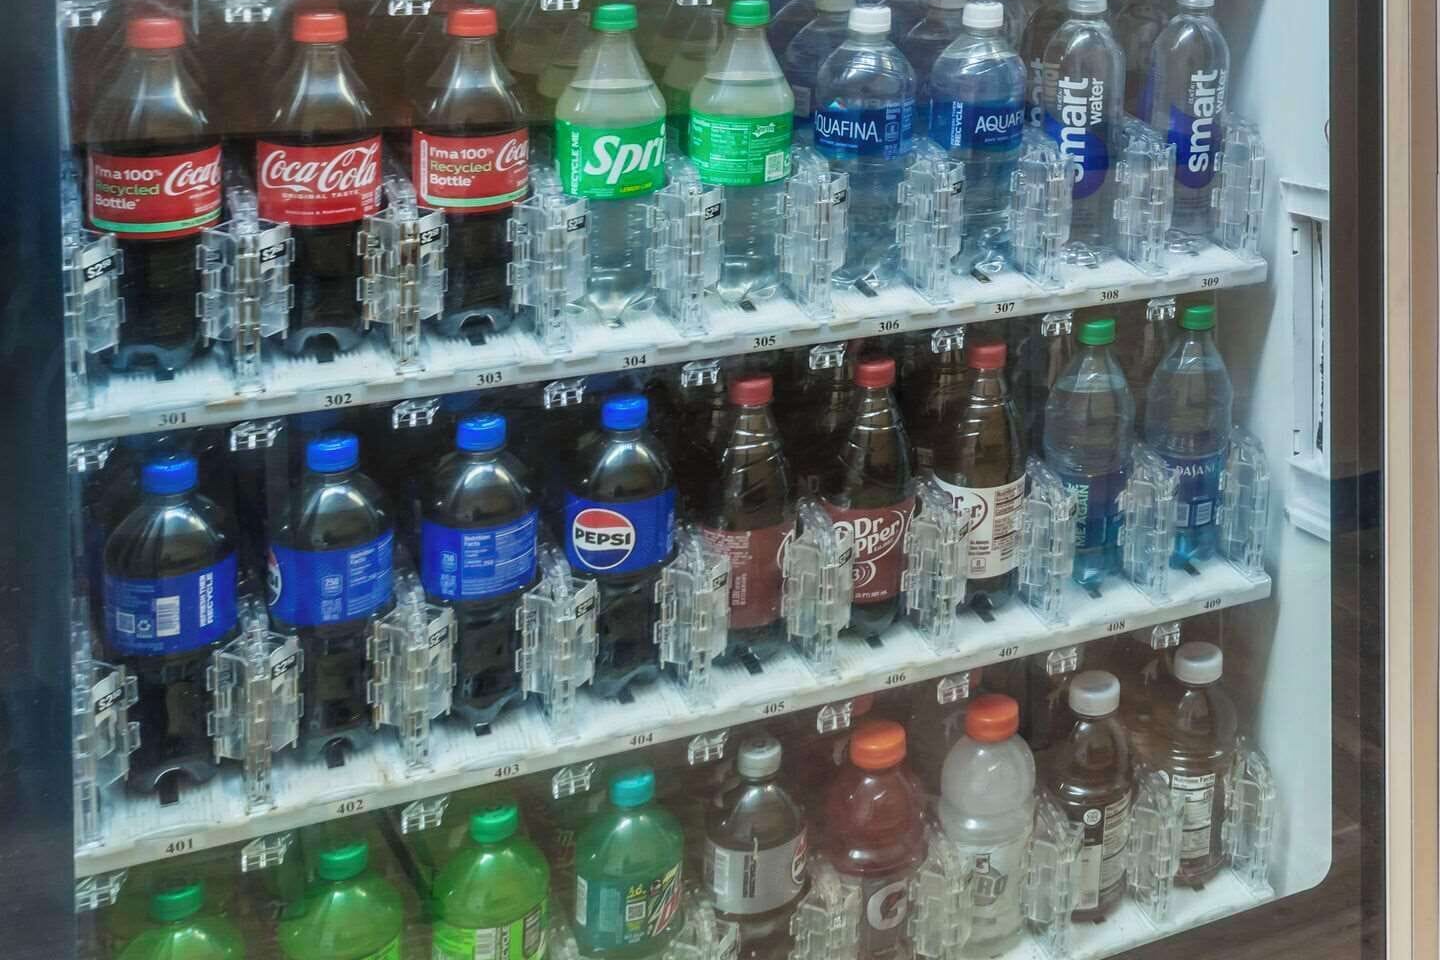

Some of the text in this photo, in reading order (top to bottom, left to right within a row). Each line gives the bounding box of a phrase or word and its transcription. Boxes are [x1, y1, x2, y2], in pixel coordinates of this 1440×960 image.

[1216, 69, 1228, 114] water
[1089, 78, 1105, 126] water
[954, 101, 964, 146] RECYCLE
[974, 111, 1024, 135] AQUAF
[1188, 69, 1218, 173] smart
[1058, 76, 1089, 183] smart
[449, 150, 458, 160] a
[459, 147, 494, 160] 100%
[583, 123, 666, 185] Spri
[261, 141, 378, 192] Coca-Cola
[430, 160, 492, 175] Recycled
[570, 132, 580, 195] RECYCLE ME
[96, 180, 160, 196] Recycled
[281, 190, 358, 200] ORIGINAL TASTE
[1201, 276, 1220, 288] 309
[1100, 289, 1120, 302] 308
[994, 302, 1015, 315] 307
[878, 320, 900, 332] 306
[753, 336, 777, 348] 305
[622, 355, 647, 368] 304
[476, 371, 503, 385] 303
[325, 392, 353, 407] 302
[158, 413, 188, 426] 301
[854, 517, 885, 535] Dr
[575, 528, 632, 546] PEPSI
[1204, 598, 1222, 610] 409
[1106, 620, 1126, 632] 408
[998, 646, 1019, 659] 407
[885, 673, 907, 686] 406
[762, 701, 785, 715] 405
[629, 733, 654, 747] 404
[494, 764, 520, 778] 403
[335, 799, 365, 814] 402
[165, 838, 195, 854] 401
